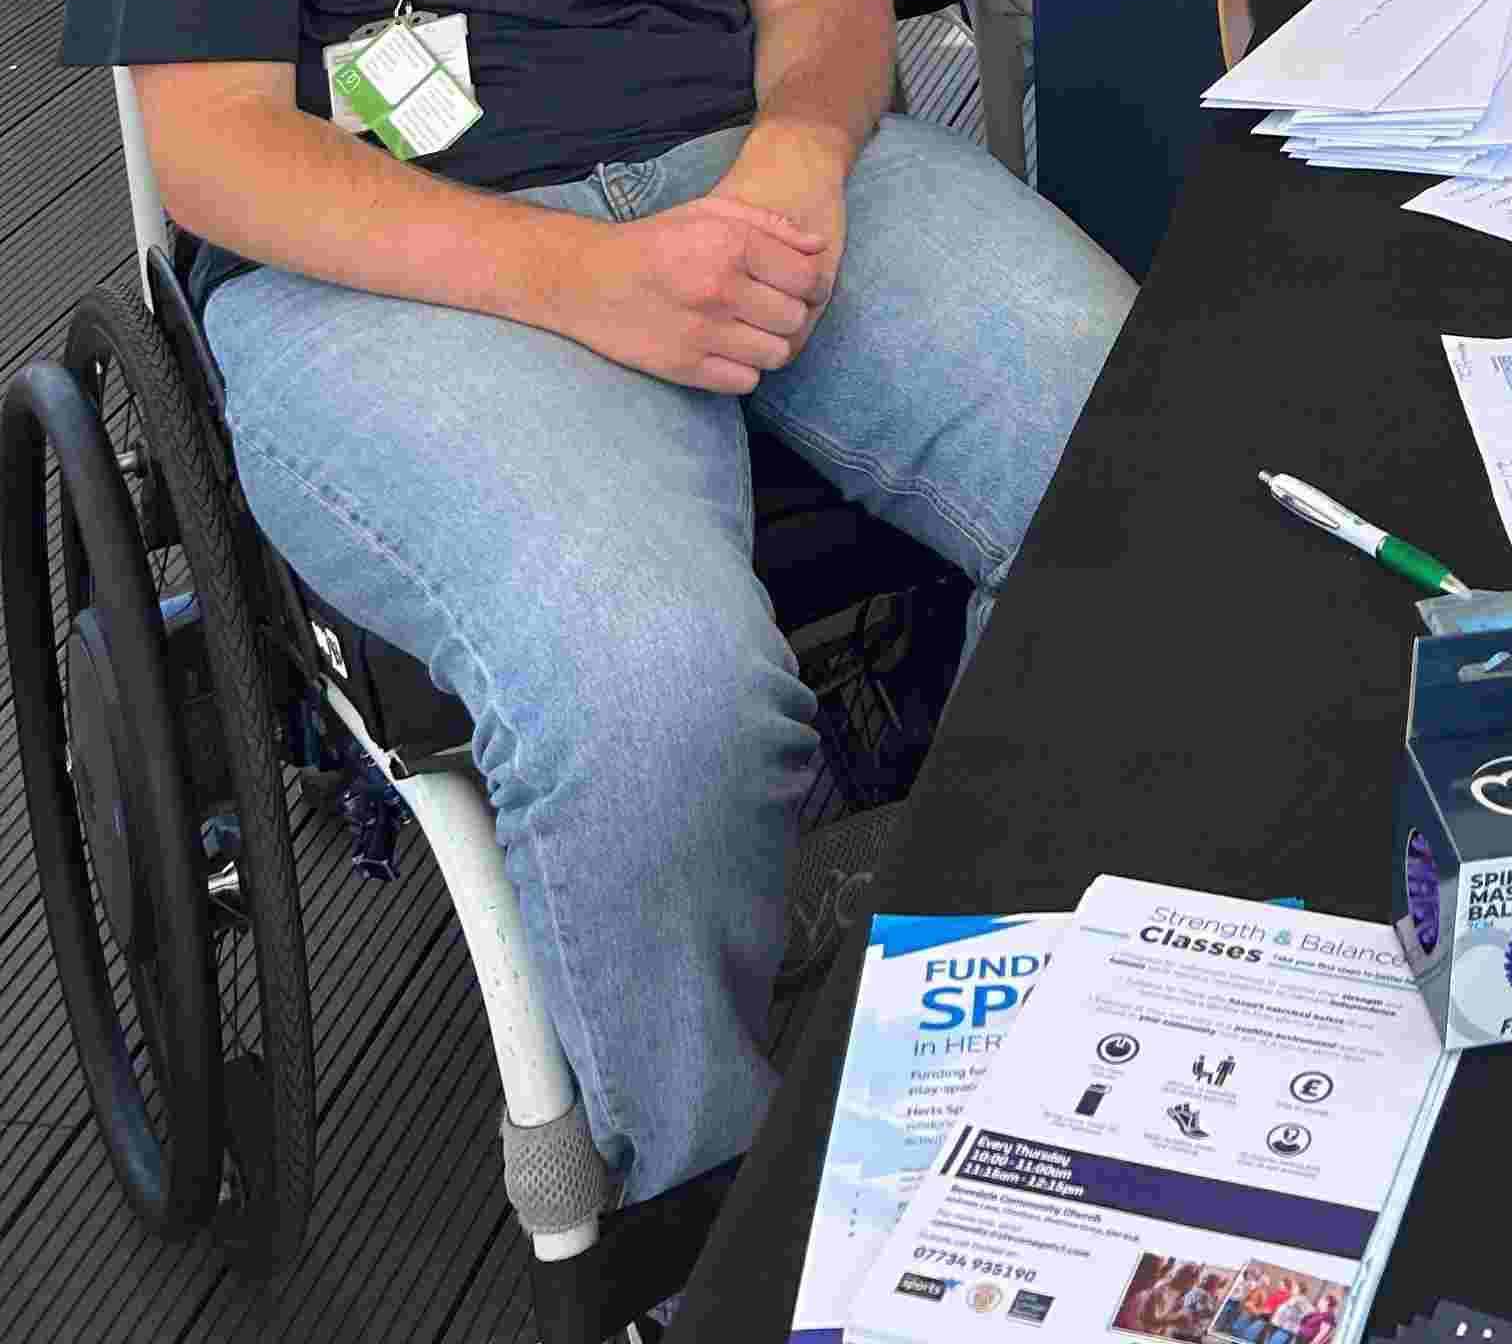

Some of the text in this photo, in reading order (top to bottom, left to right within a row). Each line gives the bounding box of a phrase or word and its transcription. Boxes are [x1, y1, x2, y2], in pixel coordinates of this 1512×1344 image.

[1139, 925, 1265, 965] Classes
[1148, 905, 1265, 943] Strength
[1272, 926, 1292, 948] &
[917, 983, 1037, 1032] SP
[975, 1134, 1073, 1167] Every Thursday
[913, 1246, 1037, 1284] 07734 935190
